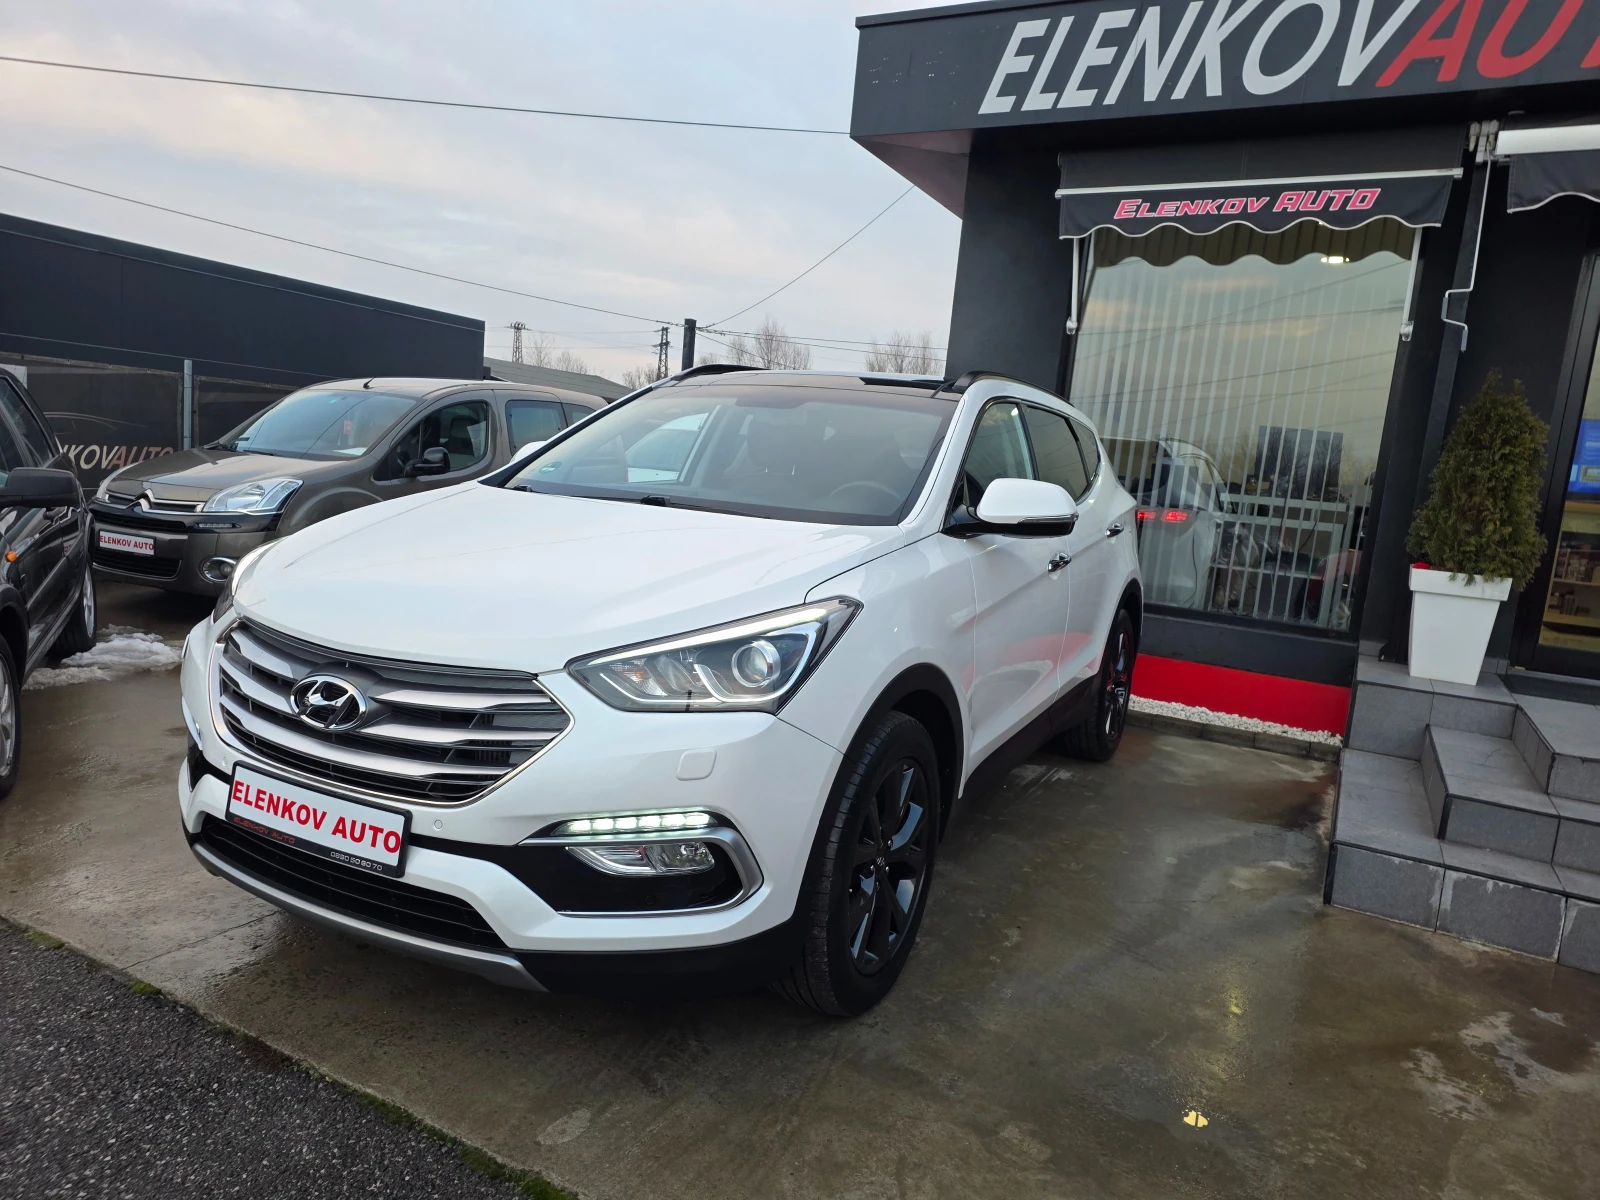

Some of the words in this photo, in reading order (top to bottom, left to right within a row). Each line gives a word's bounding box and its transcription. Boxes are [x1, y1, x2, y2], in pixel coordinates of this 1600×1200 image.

[1113, 197, 1270, 219] ELENKOV
[1273, 188, 1381, 212] AUTO
[98, 535, 131, 547] ELENKOV
[133, 542, 156, 551] AUTO
[232, 780, 327, 830] ELENKOV
[331, 816, 401, 853] AUTO
[272, 831, 296, 844] AUTO
[372, 863, 383, 871] 70
